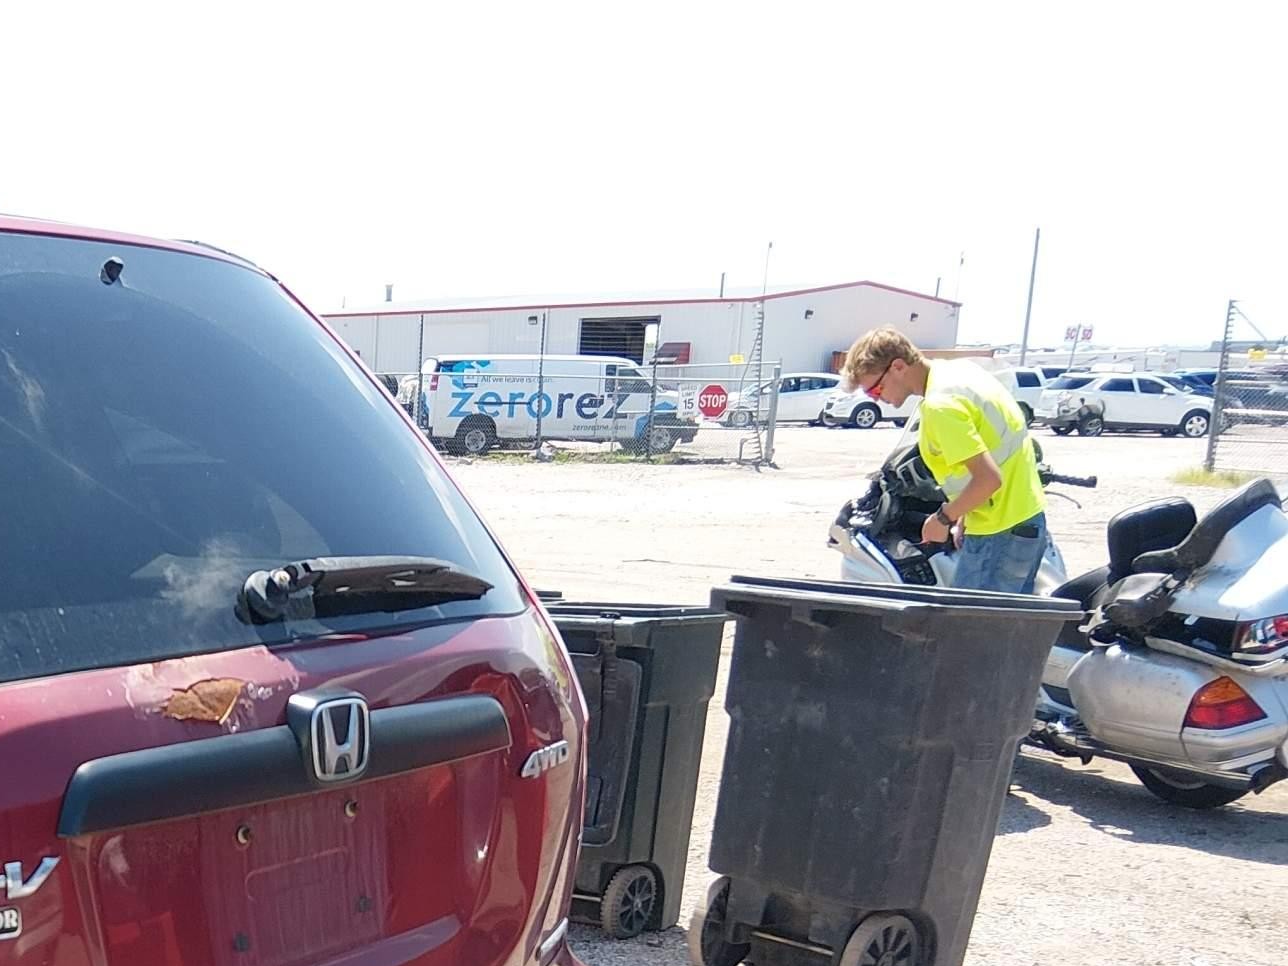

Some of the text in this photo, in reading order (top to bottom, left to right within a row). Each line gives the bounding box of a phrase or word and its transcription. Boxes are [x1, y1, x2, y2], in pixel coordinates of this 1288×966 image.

[481, 375, 491, 383] All
[505, 375, 525, 383] leave
[447, 391, 630, 419] zerorez
[683, 398, 694, 410] 15
[699, 394, 727, 408] STOP
[520, 740, 569, 779] 4WD
